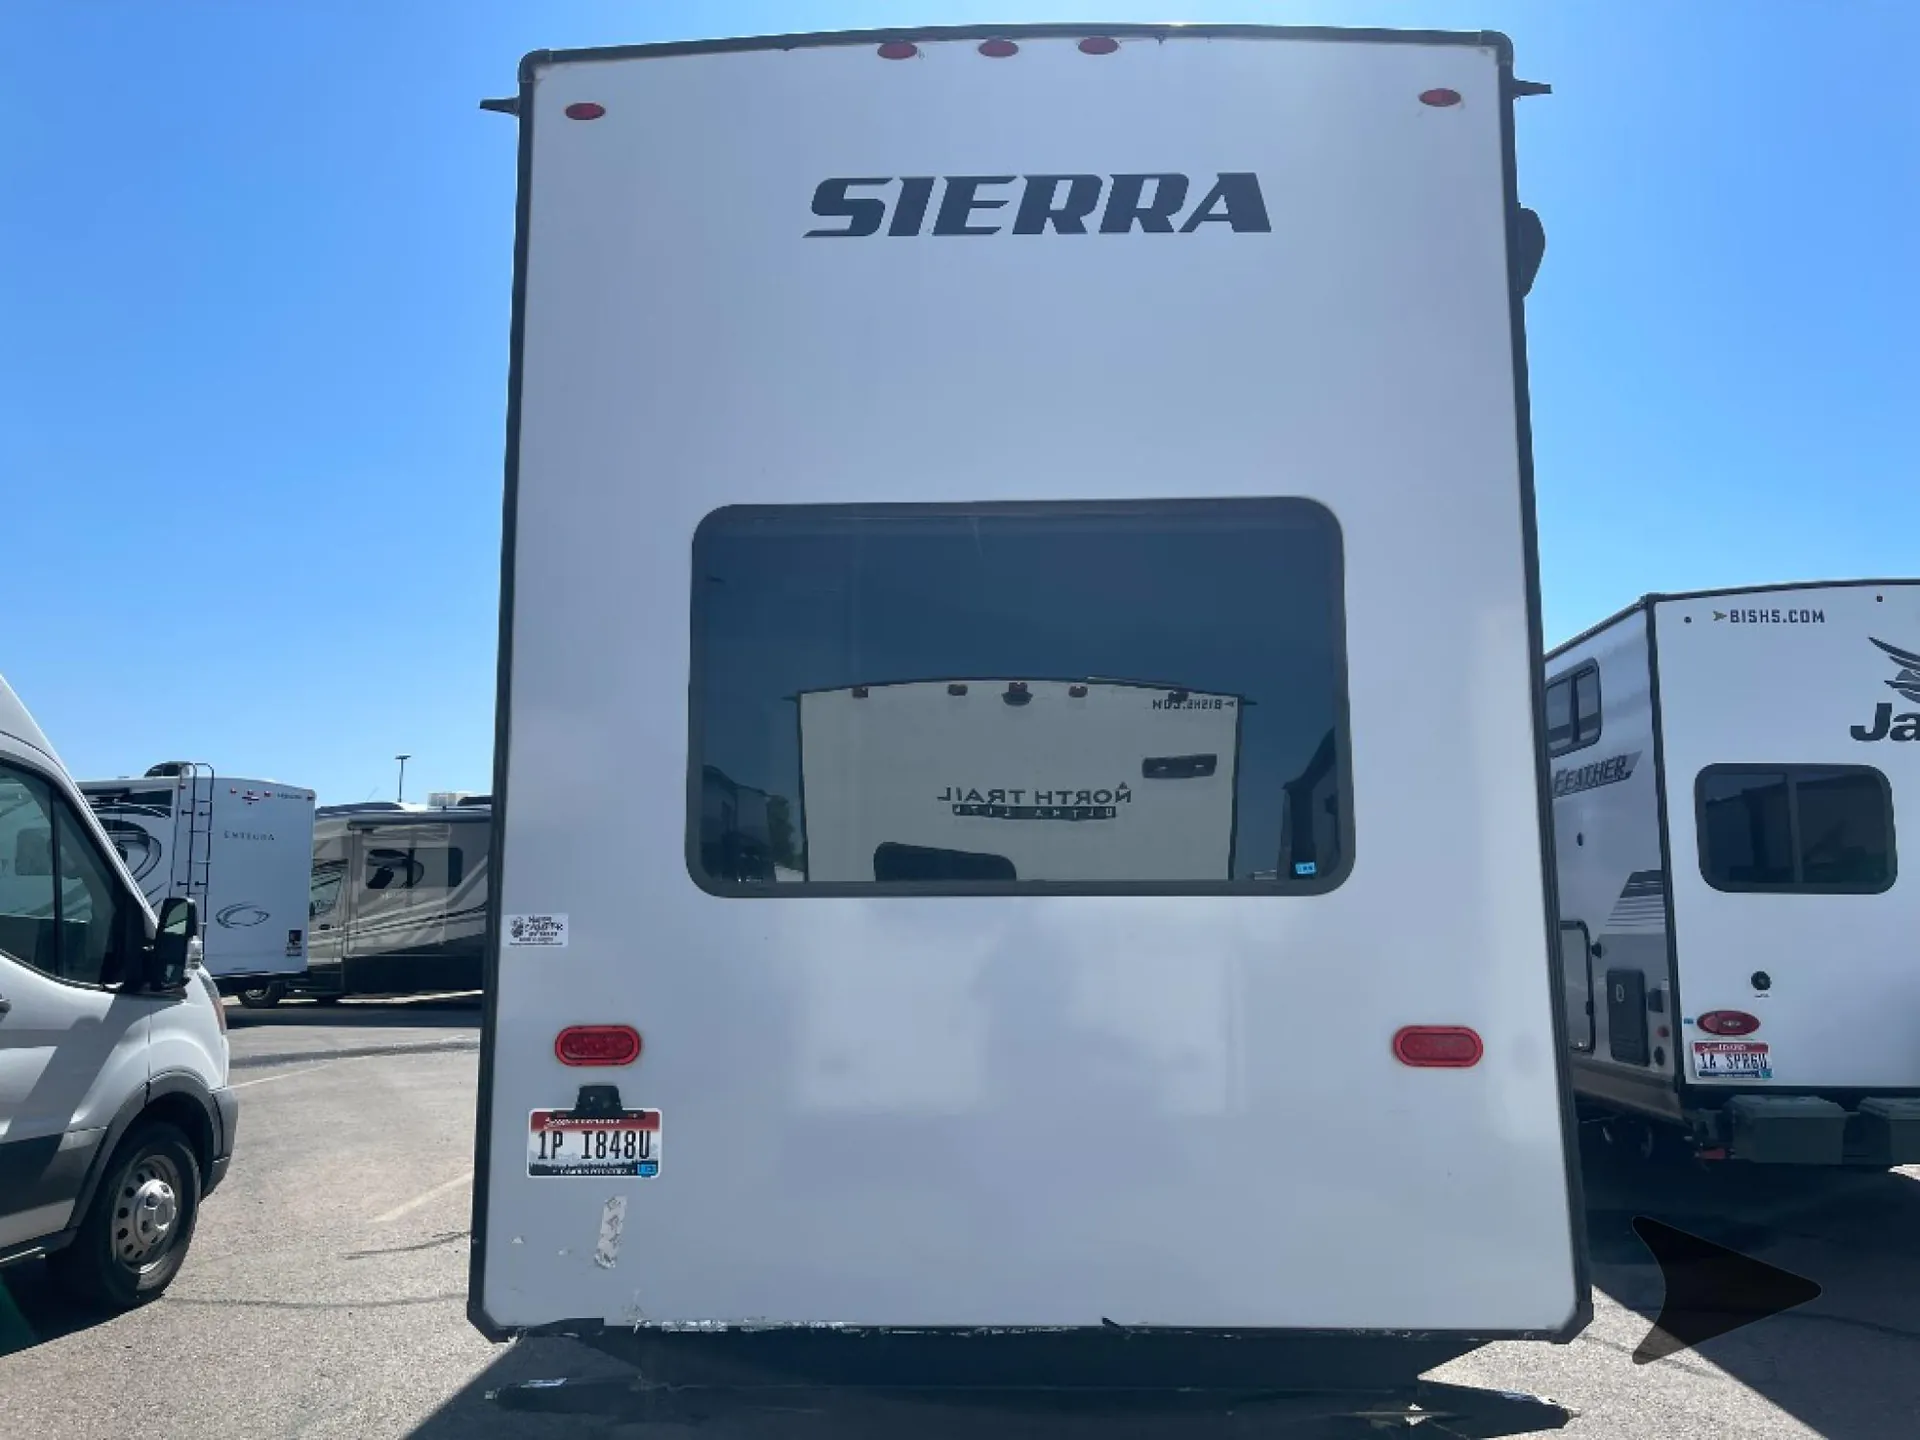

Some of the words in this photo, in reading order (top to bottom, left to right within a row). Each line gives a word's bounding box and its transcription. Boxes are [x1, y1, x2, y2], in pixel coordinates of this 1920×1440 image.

[802, 172, 1272, 238] SIERRA
[1730, 609, 1825, 623] BISHS.COM
[1554, 754, 1628, 795] FEATHER
[538, 1130, 563, 1160] 1P
[581, 1129, 651, 1160] I848U
